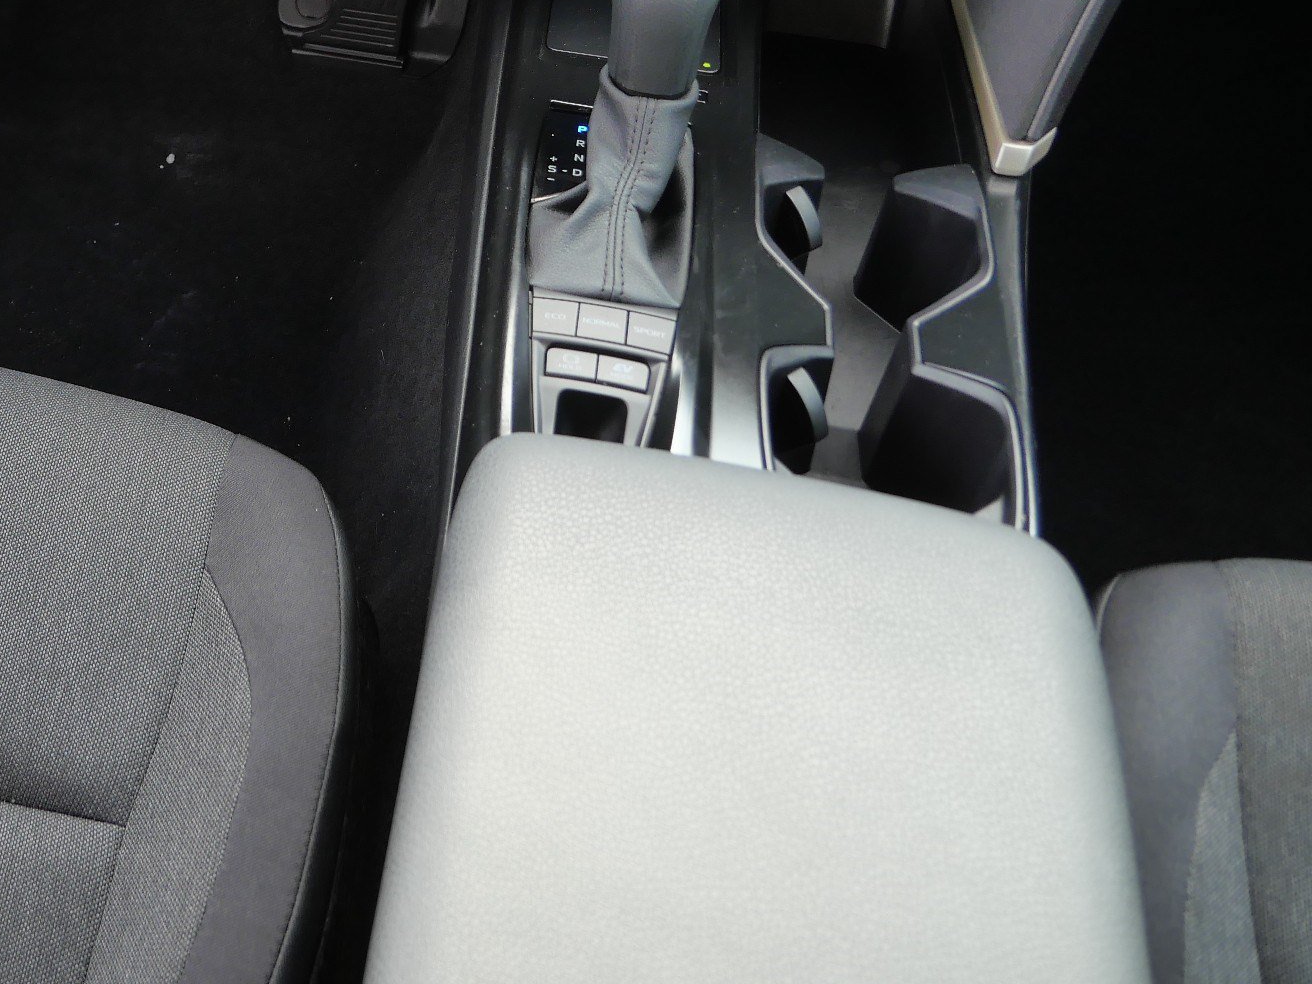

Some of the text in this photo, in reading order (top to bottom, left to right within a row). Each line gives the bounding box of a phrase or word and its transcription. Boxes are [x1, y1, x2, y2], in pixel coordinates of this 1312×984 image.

[578, 125, 588, 133] P
[576, 139, 585, 148] R
[574, 153, 584, 162] N
[548, 165, 583, 177] S D
[582, 316, 620, 330] NORMAL
